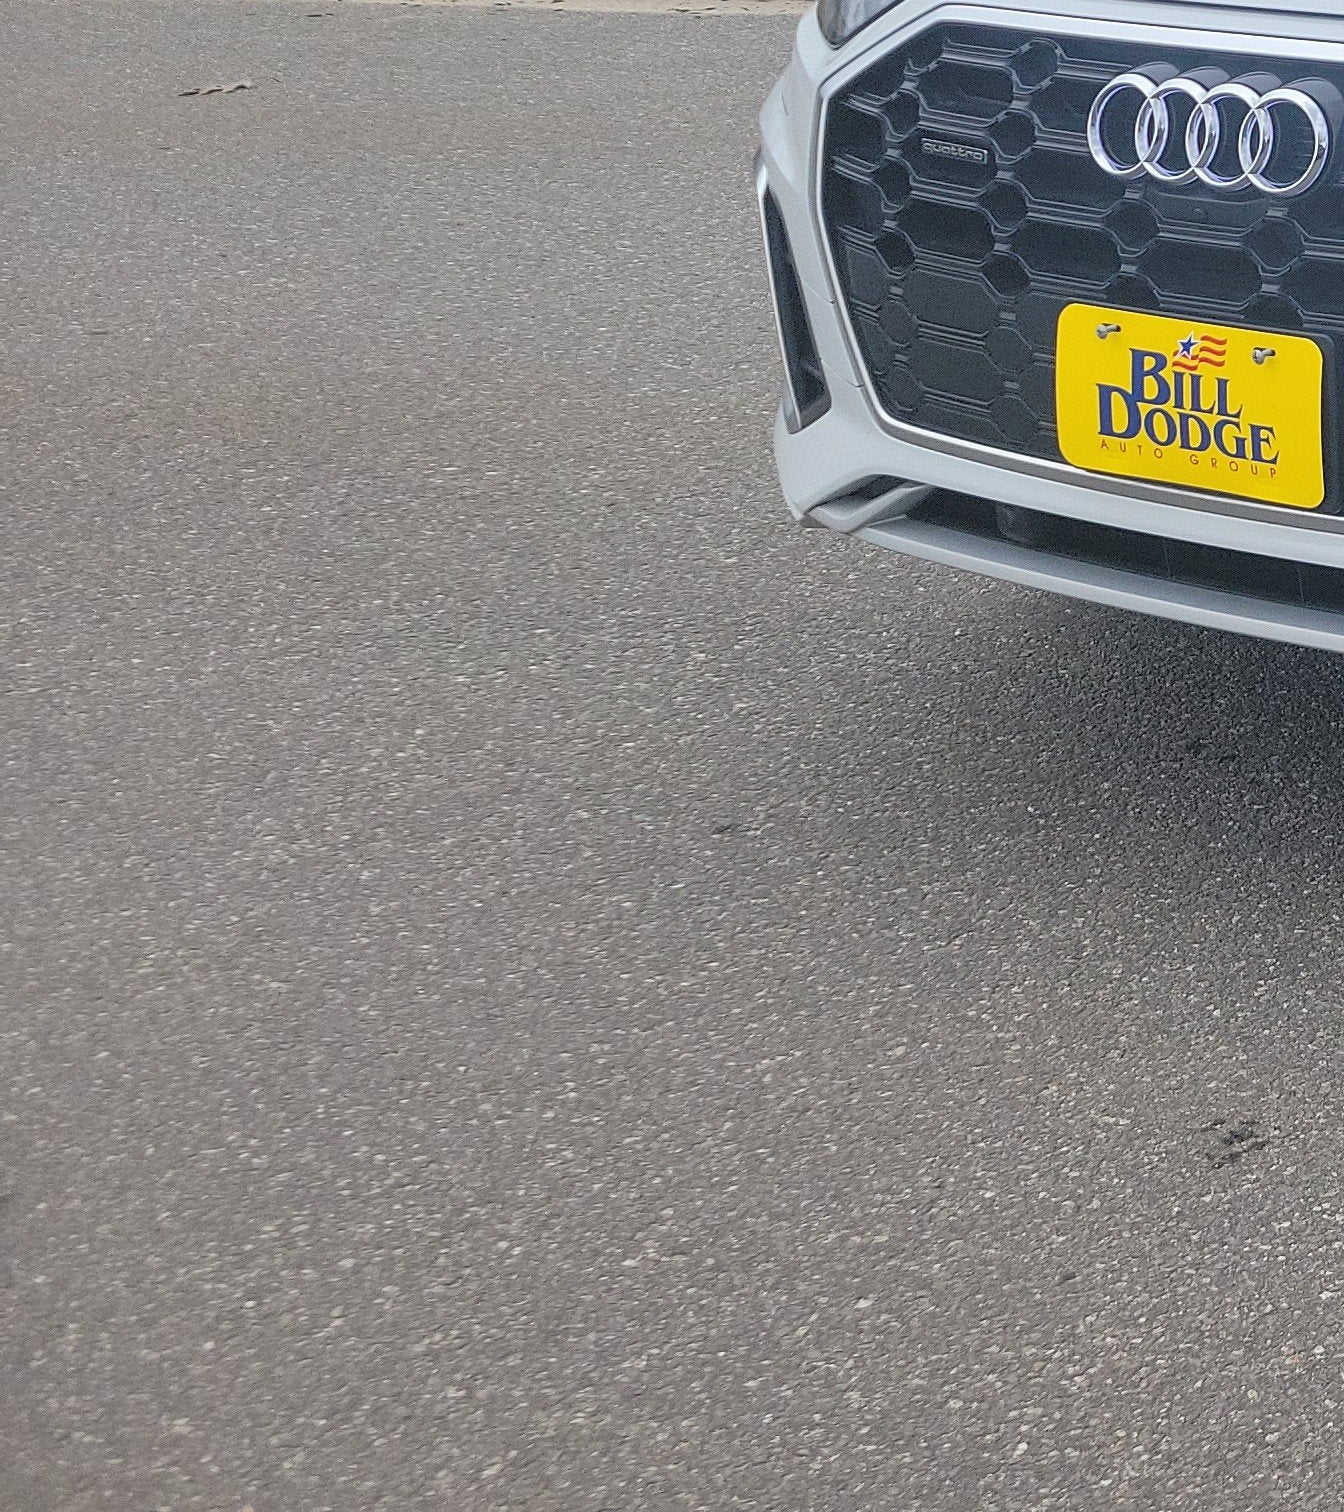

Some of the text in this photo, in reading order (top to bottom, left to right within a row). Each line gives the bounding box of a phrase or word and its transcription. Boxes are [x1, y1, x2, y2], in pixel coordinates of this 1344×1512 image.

[1128, 347, 1244, 420] BILL
[1096, 382, 1281, 465] DODGE
[1100, 439, 1279, 479] AUTO GROUP
